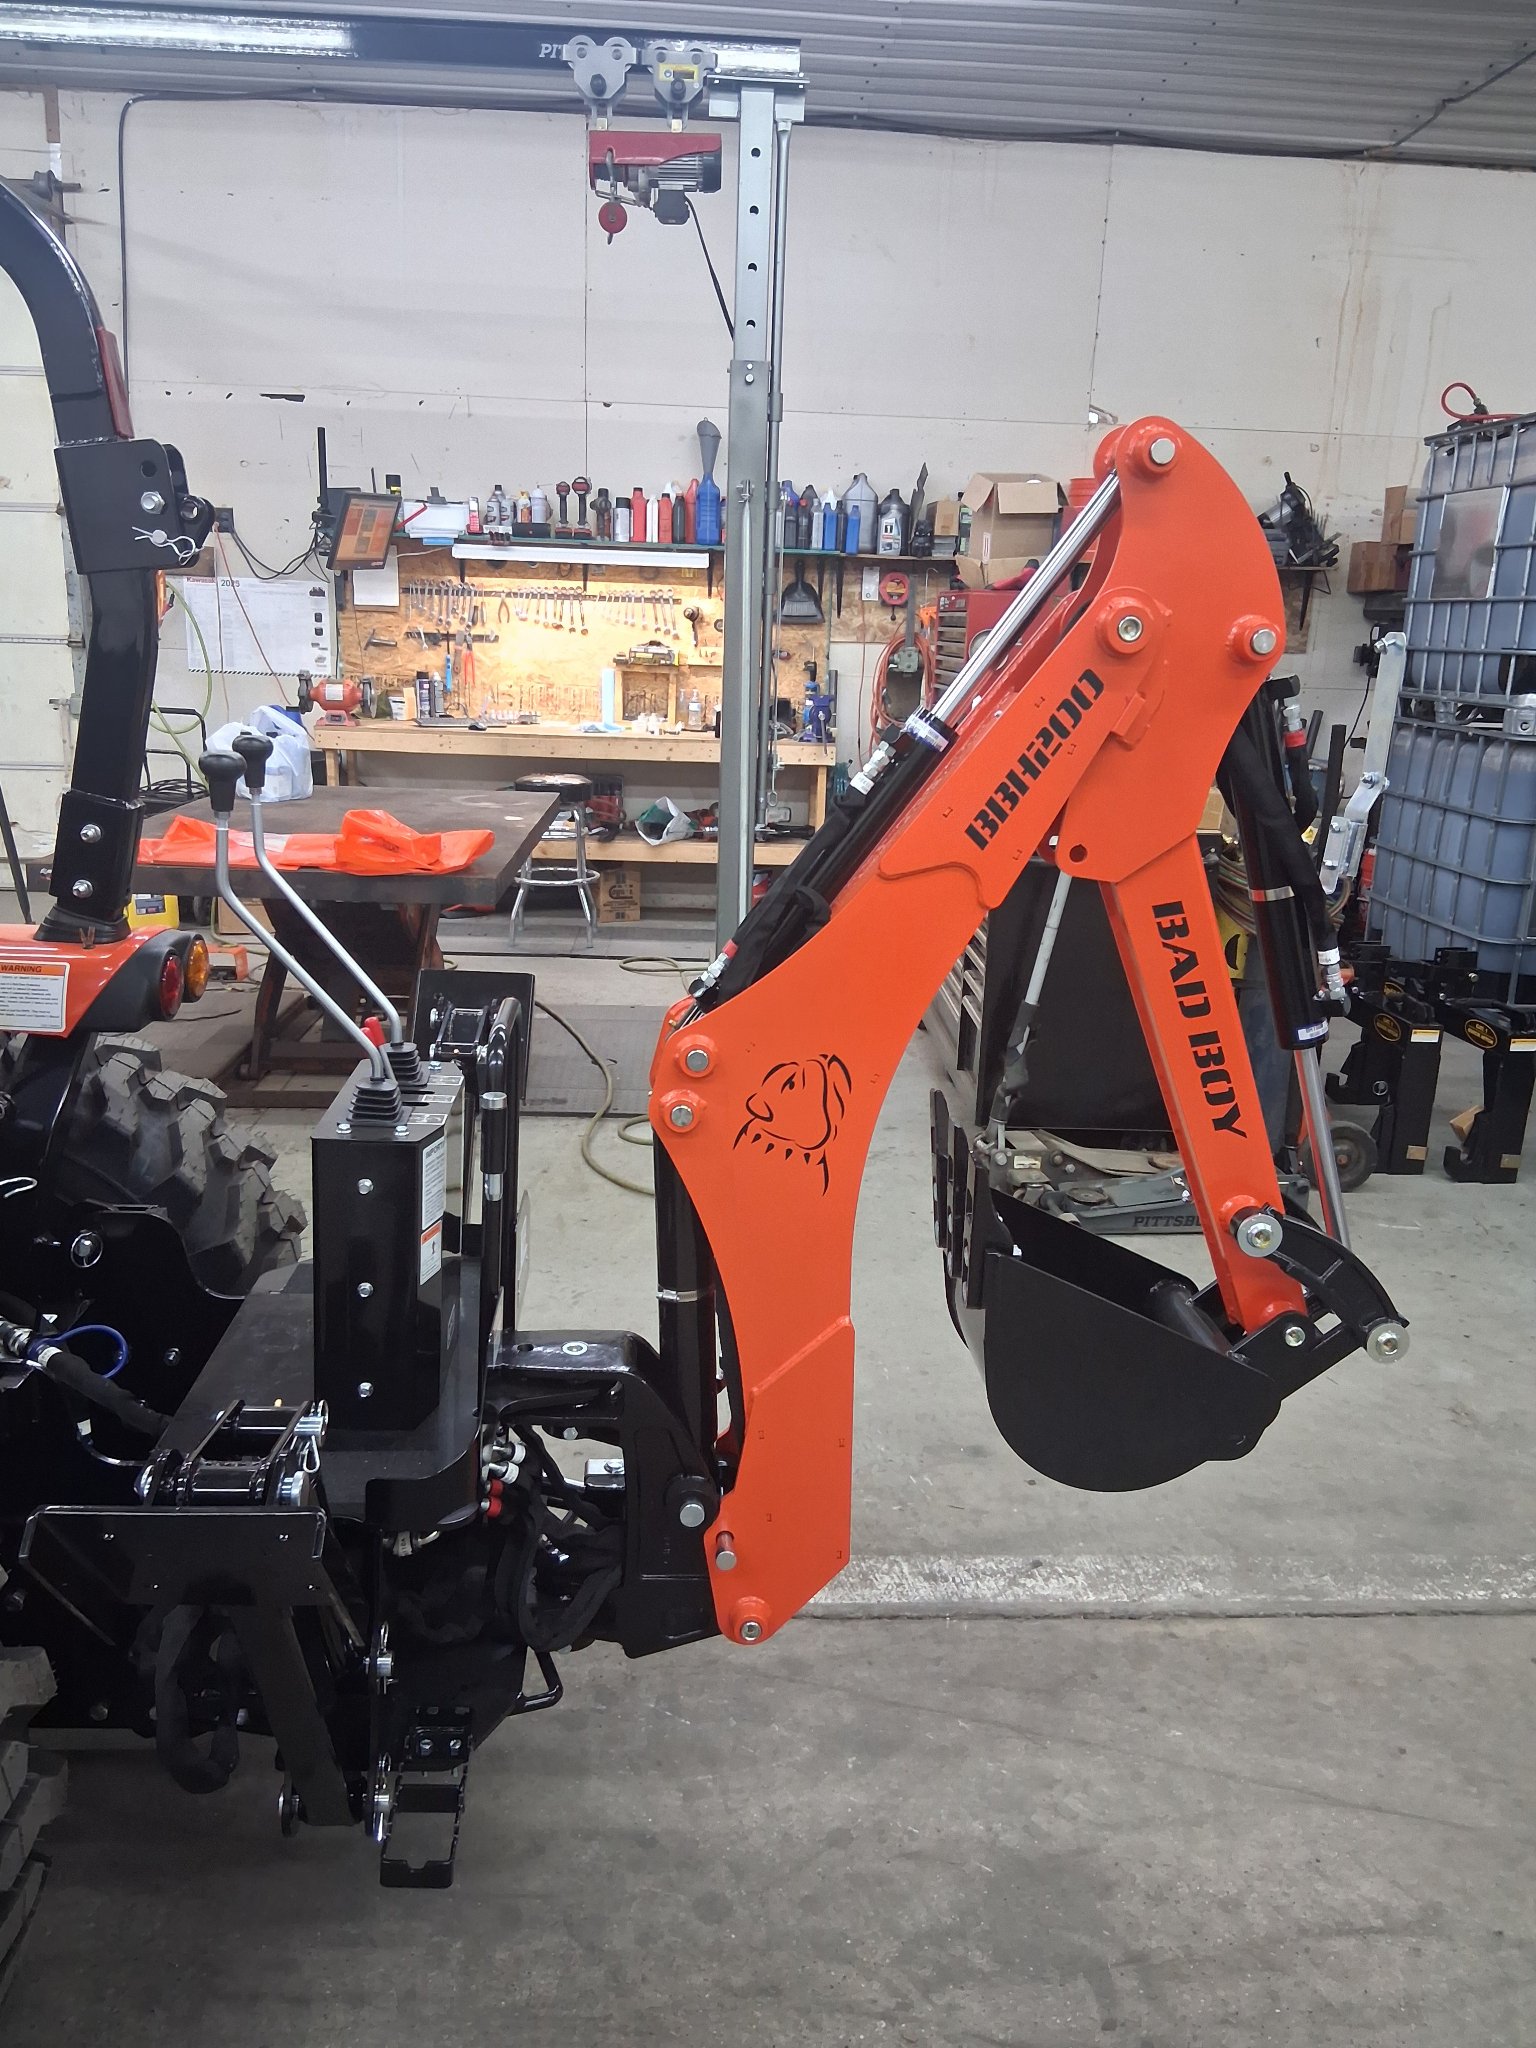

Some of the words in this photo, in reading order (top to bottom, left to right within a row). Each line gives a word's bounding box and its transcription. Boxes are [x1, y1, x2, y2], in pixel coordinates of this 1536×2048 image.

[186, 576, 216, 584] Kawasak
[0, 965, 42, 973] WARNING
[1152, 901, 1212, 1019] BAD
[1188, 1030, 1248, 1138] BOY
